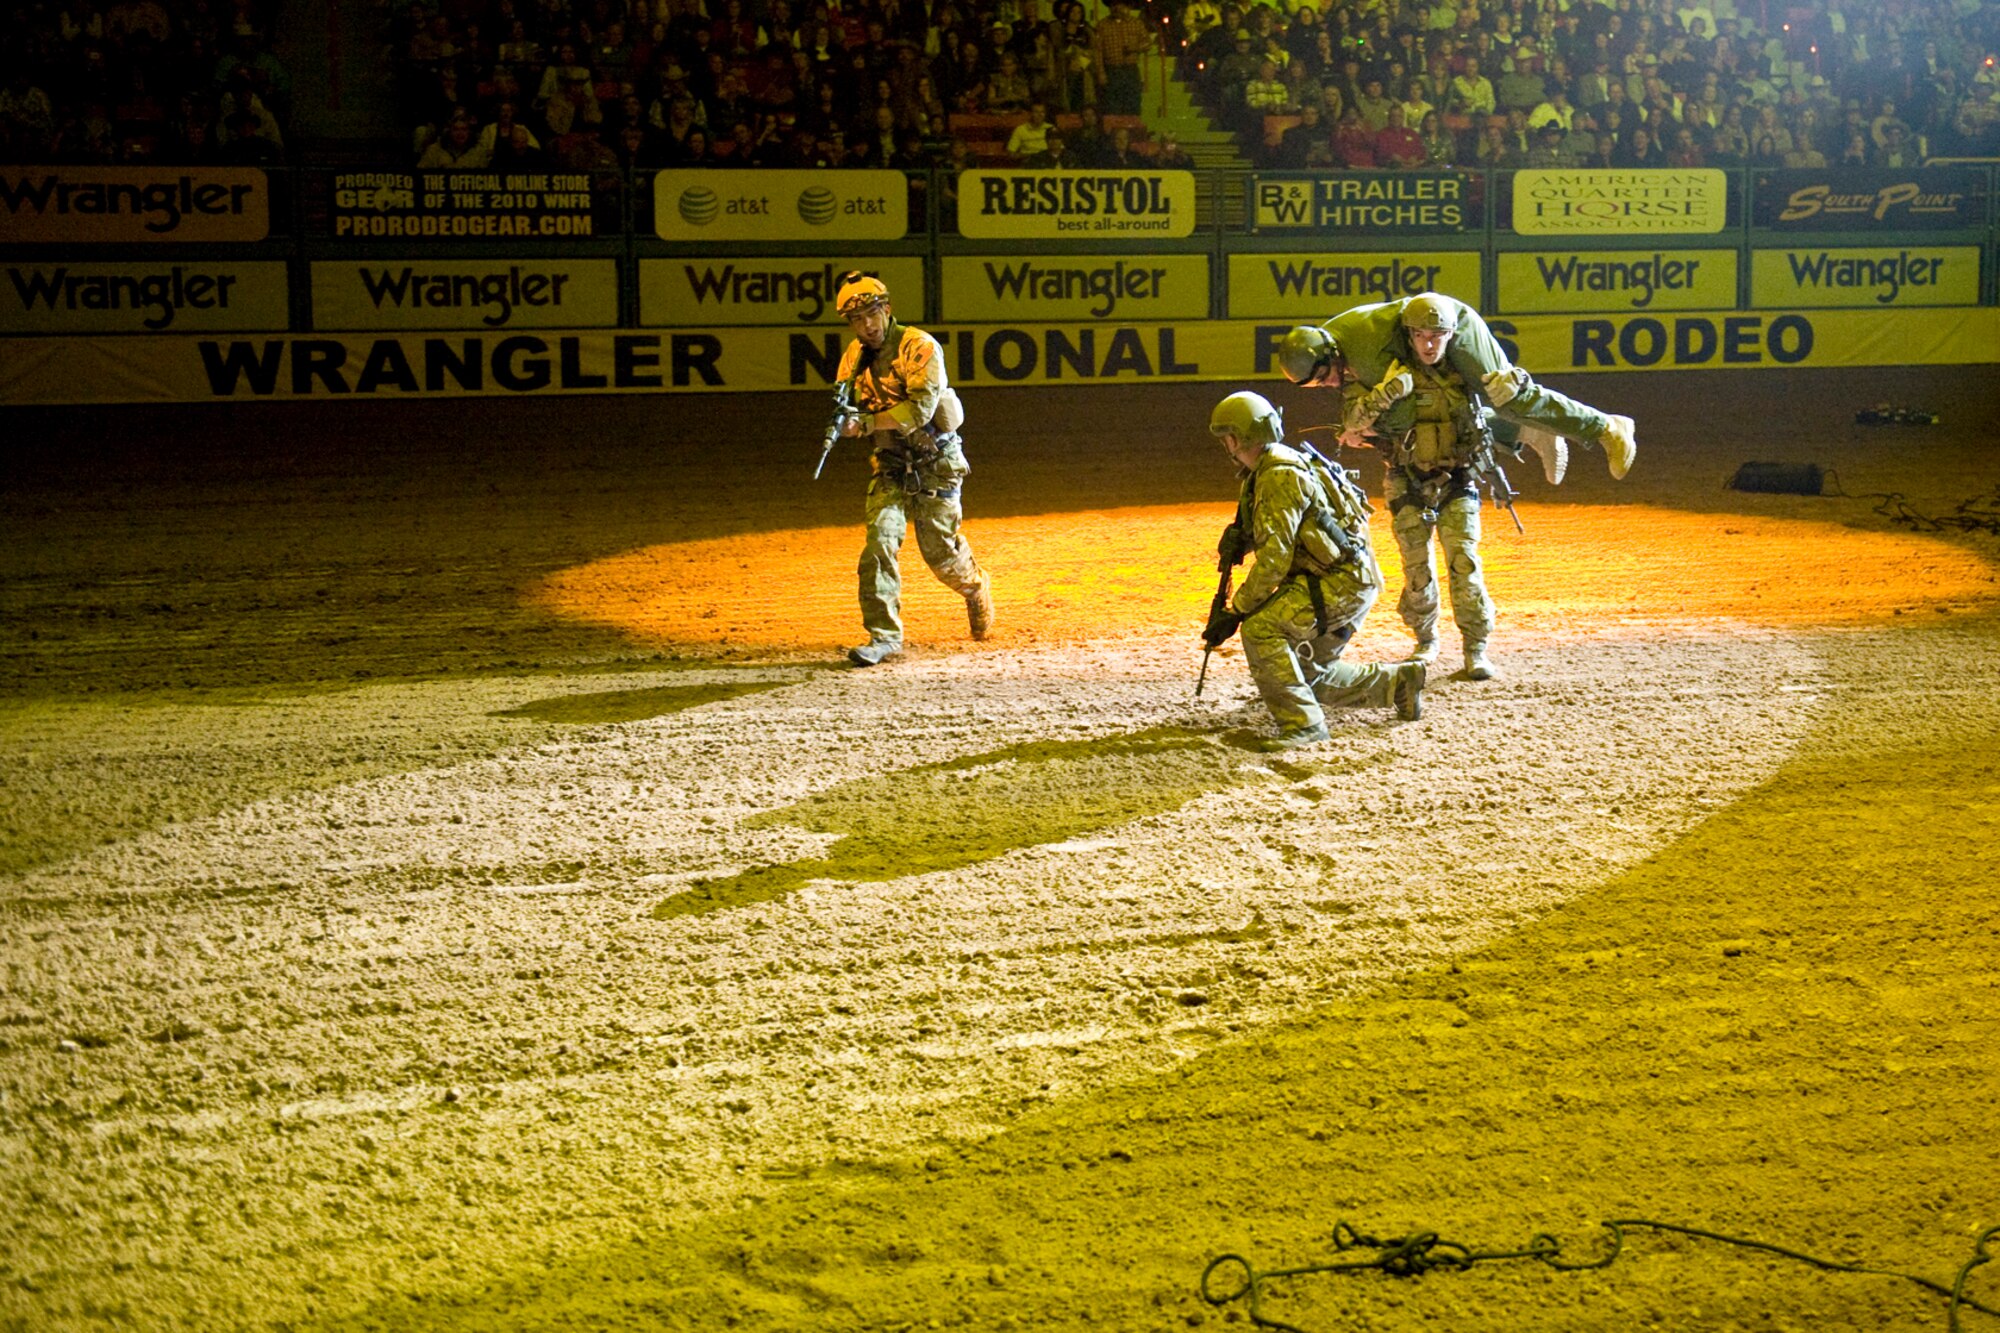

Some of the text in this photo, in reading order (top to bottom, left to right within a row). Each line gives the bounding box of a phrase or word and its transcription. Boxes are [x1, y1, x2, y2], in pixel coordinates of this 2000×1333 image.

[335, 173, 413, 189] PRORODEO
[423, 174, 591, 191] THE OFFICIAL ONLINE STORE
[1320, 180, 1460, 200] TRAILER
[1530, 176, 1708, 185] AMERICAN
[0, 175, 252, 232] Wrangler
[423, 193, 591, 209] OF THE 2010 WNFR
[981, 177, 1170, 215] RESISTOL
[1530, 189, 1706, 200] QUARTER
[726, 197, 769, 214] at&t
[844, 197, 886, 214] at&t
[1321, 205, 1462, 225] HITCHES
[335, 215, 592, 236] PRORODEOGEAR.COM
[1057, 217, 1170, 230] best all-around
[1531, 219, 1707, 228] ASSOCIATION
[1268, 258, 1441, 303] Wrangler
[1536, 254, 1700, 307] Wrangler
[1787, 251, 1944, 303] Wrangler
[9, 268, 236, 328] Wrangler
[359, 267, 569, 325] Wrangler
[684, 263, 879, 321] Wrangl
[984, 261, 1166, 317] Wrangler
[199, 335, 724, 395] WRANGLER
[789, 328, 1199, 385] NIONAL
[1571, 314, 1815, 367] RODEO
